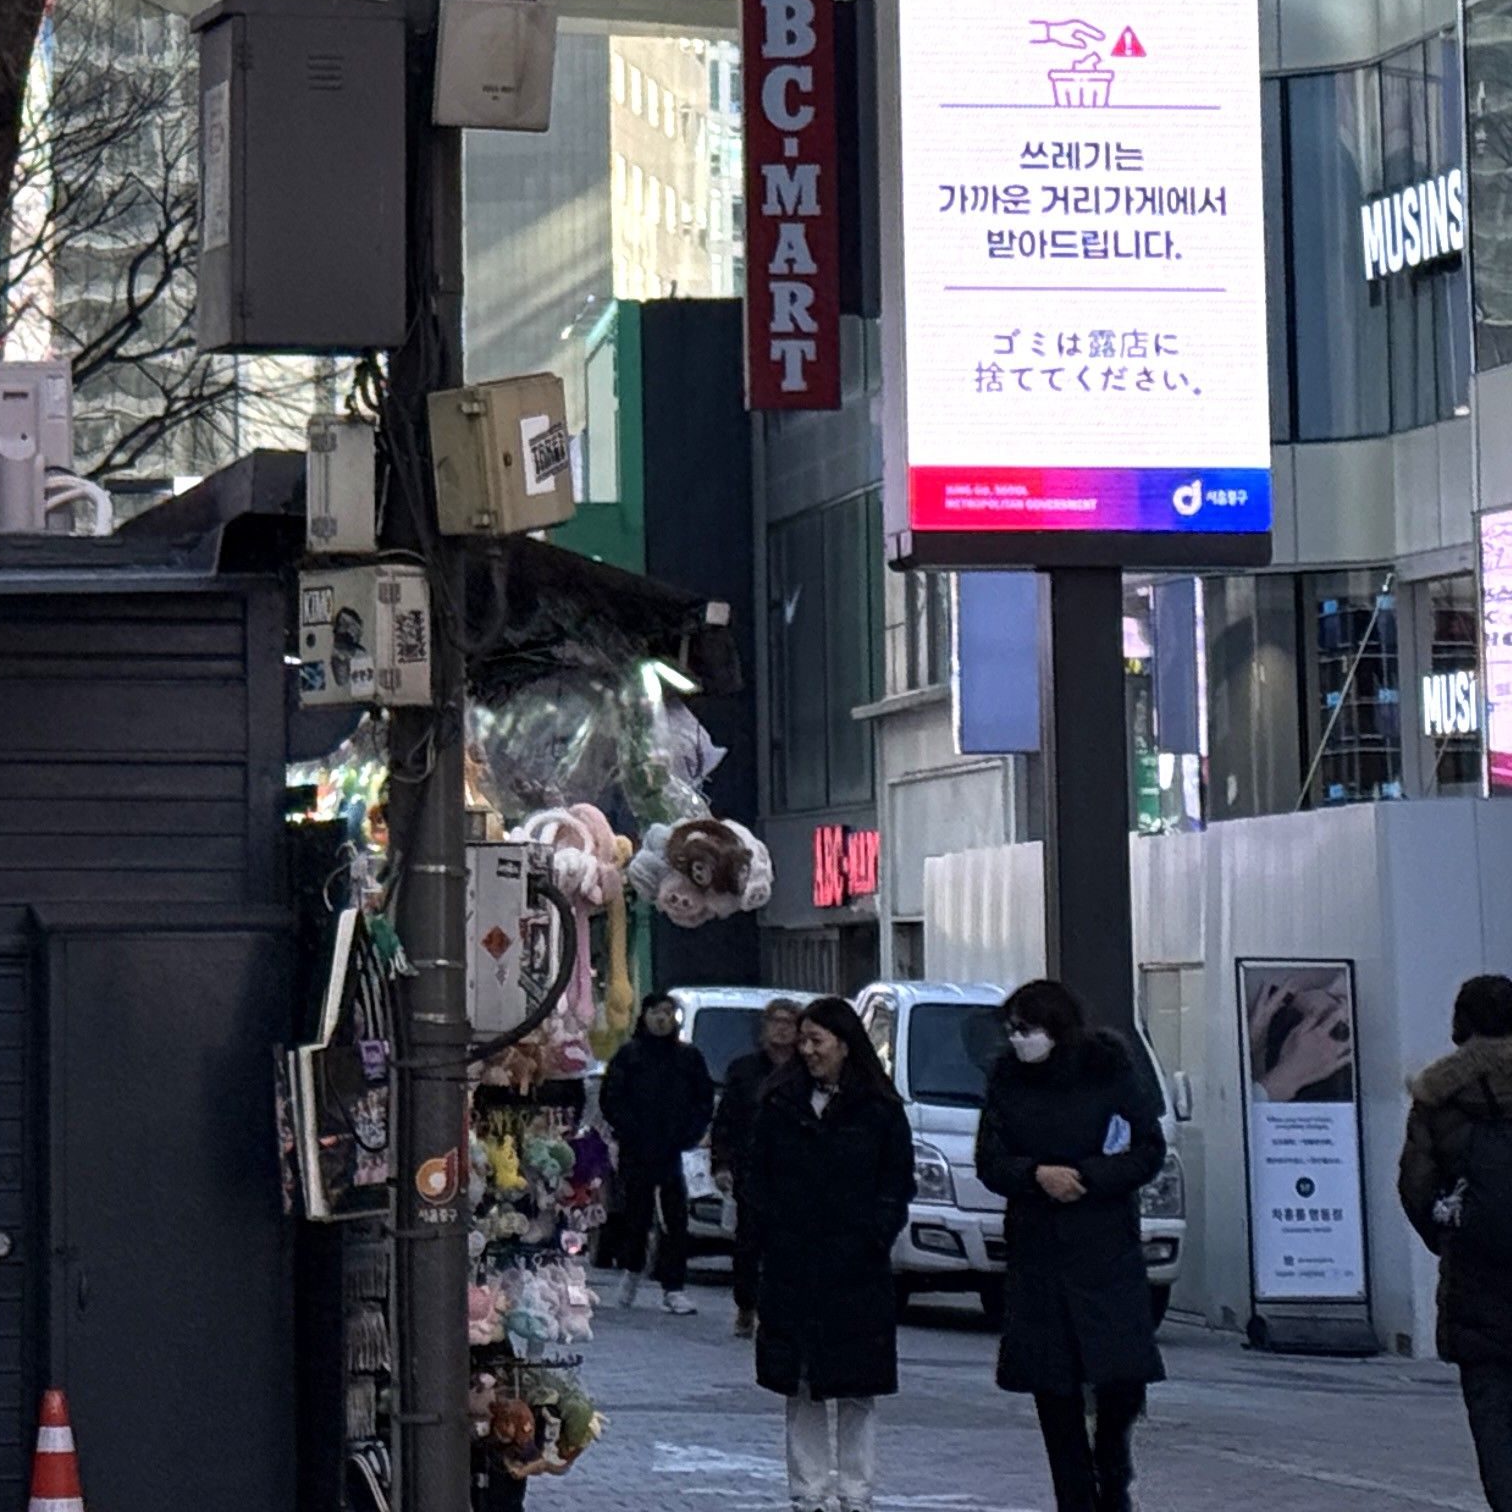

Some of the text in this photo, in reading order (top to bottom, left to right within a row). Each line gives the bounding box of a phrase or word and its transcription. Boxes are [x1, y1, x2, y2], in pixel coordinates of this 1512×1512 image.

[1019, 141, 1144, 172] 쓰레기는
[938, 184, 1227, 217] 가까운 거리가게에서
[987, 229, 1183, 261] 받아드립니다.
[993, 327, 1179, 359] ゴミは露店に
[975, 359, 1203, 397] 捨ててください。
